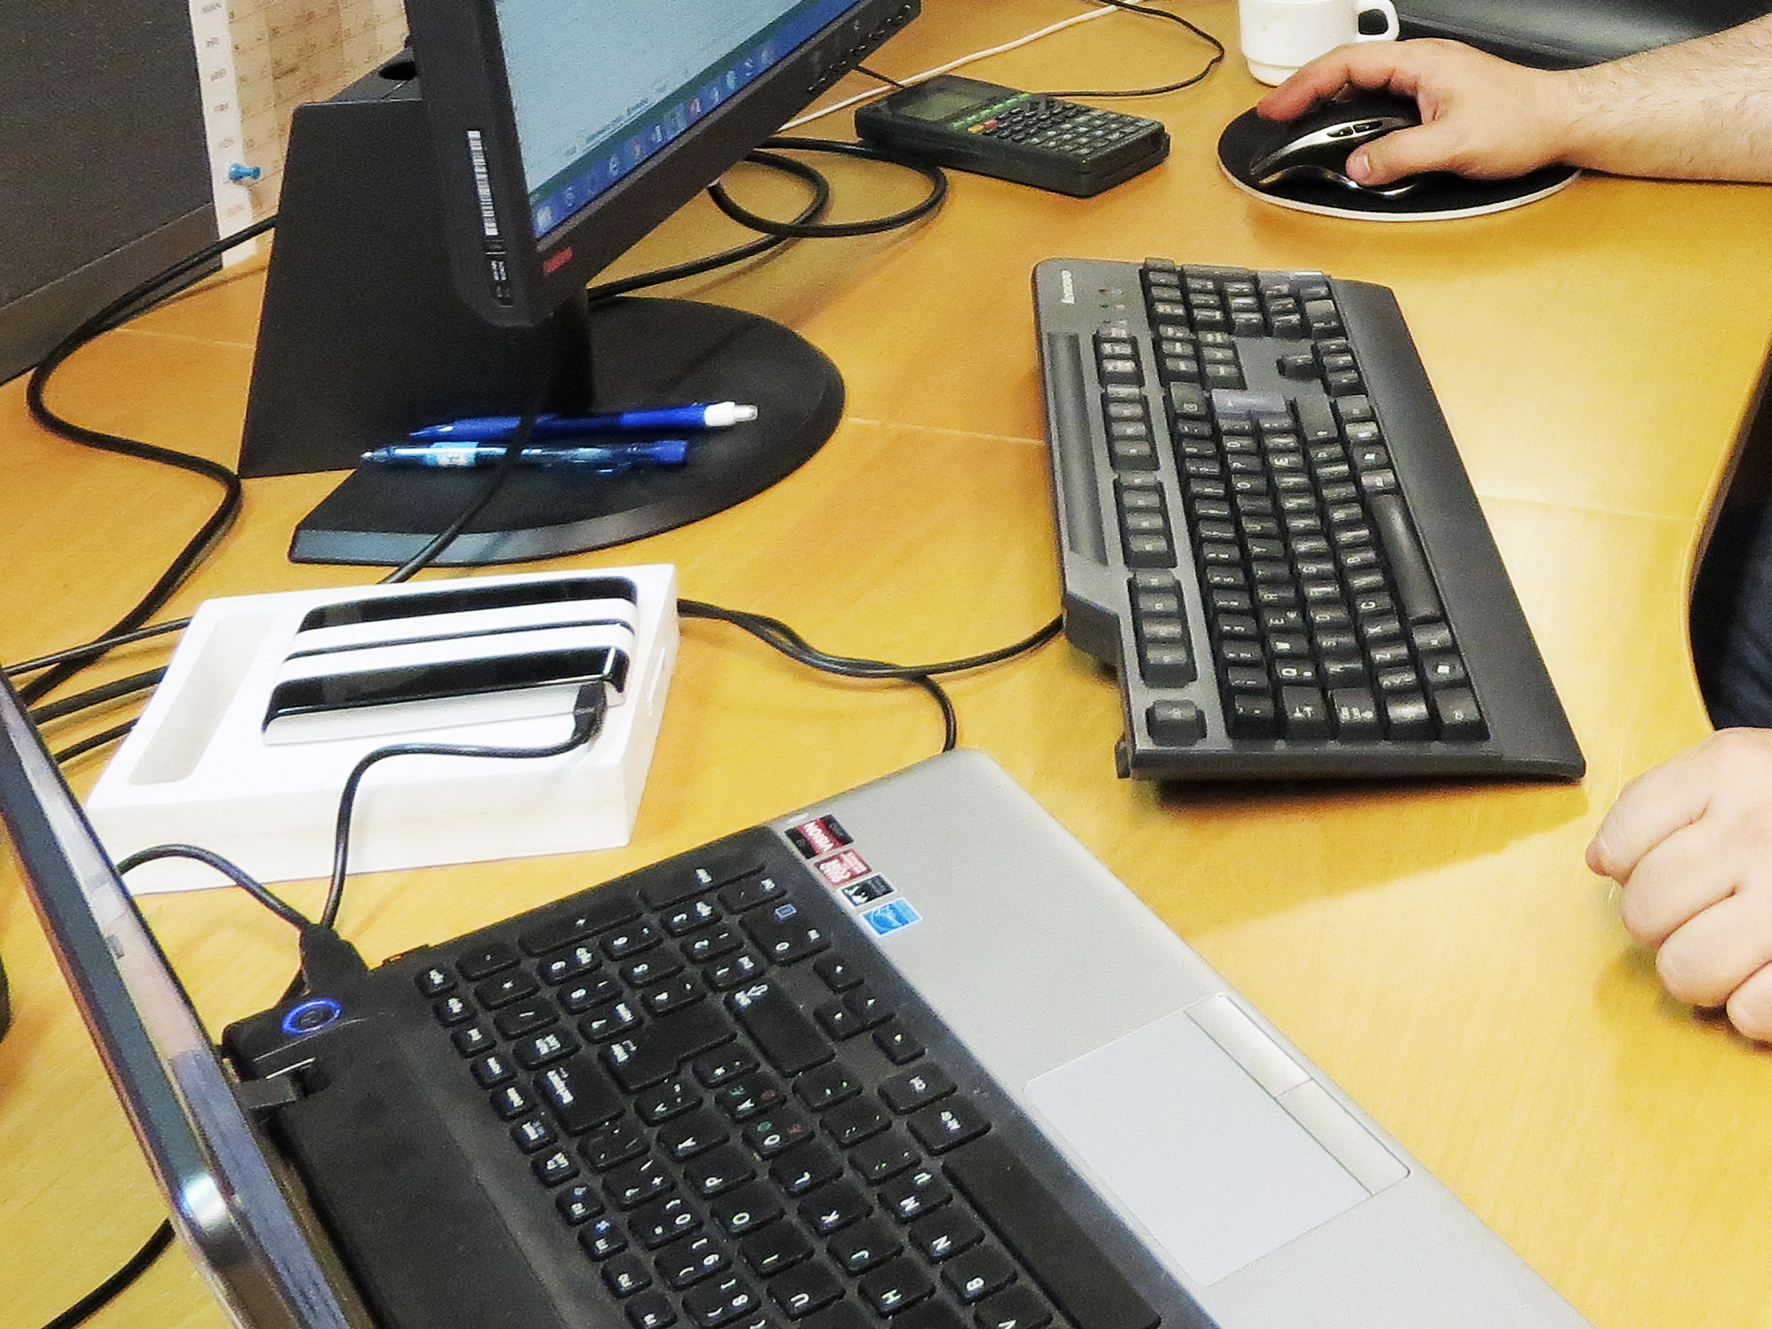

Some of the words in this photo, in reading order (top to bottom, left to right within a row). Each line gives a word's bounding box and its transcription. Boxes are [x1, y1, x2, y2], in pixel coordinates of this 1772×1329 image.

[802, 821, 835, 852] VISION
[706, 1178, 722, 1187] P
[795, 1172, 810, 1185] L
[900, 1197, 919, 1212] M
[822, 1211, 839, 1224] K
[932, 1236, 950, 1251] N
[852, 1251, 869, 1259] J
[966, 1278, 984, 1291] B
[791, 1294, 809, 1307] U
[882, 1290, 901, 1304] H
